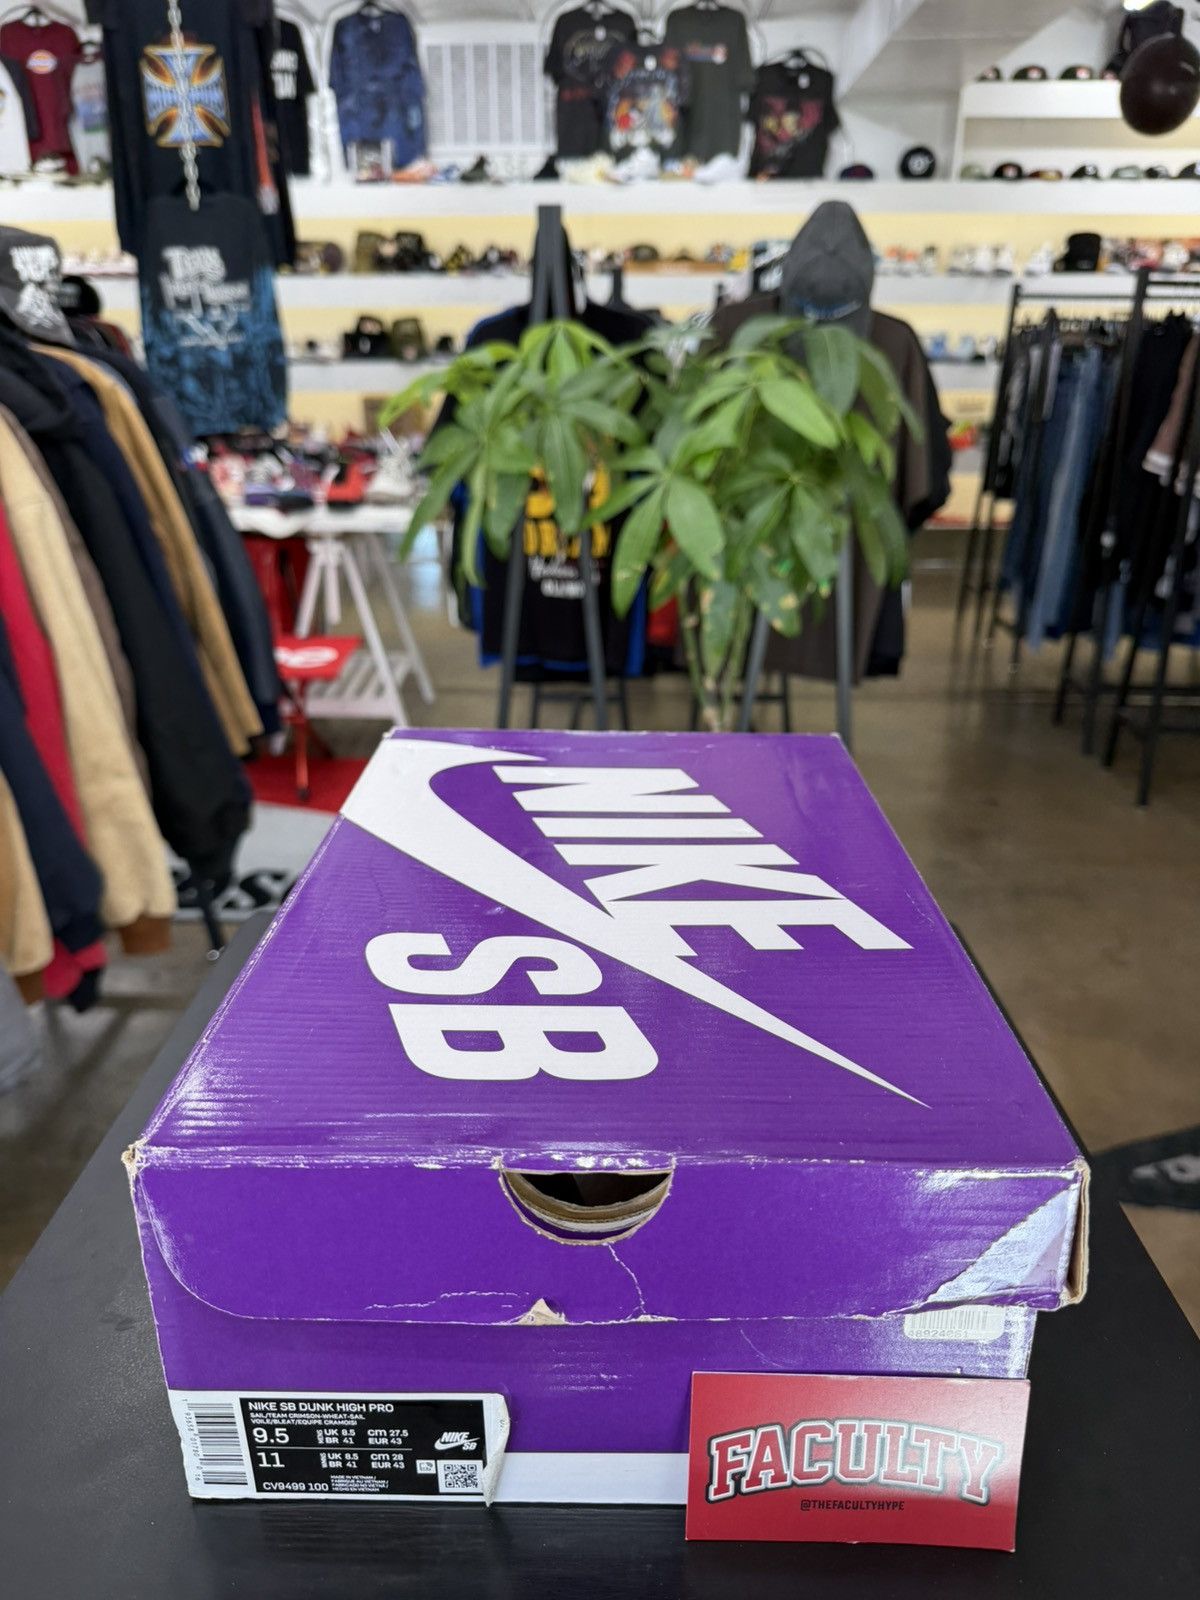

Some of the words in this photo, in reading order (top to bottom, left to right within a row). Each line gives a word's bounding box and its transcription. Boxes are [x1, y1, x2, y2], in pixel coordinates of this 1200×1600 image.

[492, 765, 914, 956] NIKE
[365, 932, 659, 1081] SB
[248, 1401, 277, 1411] NIKE
[280, 1401, 297, 1411] SB
[299, 1402, 334, 1412] DUNK
[336, 1403, 366, 1412] HIGH
[368, 1403, 394, 1413] PRO
[252, 1427, 290, 1444] 9.5
[389, 1429, 409, 1437] 27.5
[441, 1431, 470, 1443] NIKE
[368, 1437, 389, 1445] EUR
[462, 1442, 477, 1450] SB
[257, 1452, 285, 1468] 11
[327, 1452, 342, 1460] UK
[392, 1453, 404, 1461] 28
[329, 1460, 342, 1468] BR
[371, 1461, 391, 1469] EUR
[393, 1461, 405, 1469] 43
[707, 1419, 1004, 1505] FACULTY
[262, 1481, 306, 1491] CV9499
[308, 1482, 329, 1492] 100
[800, 1499, 905, 1512] @THEFACULTYHYPE
